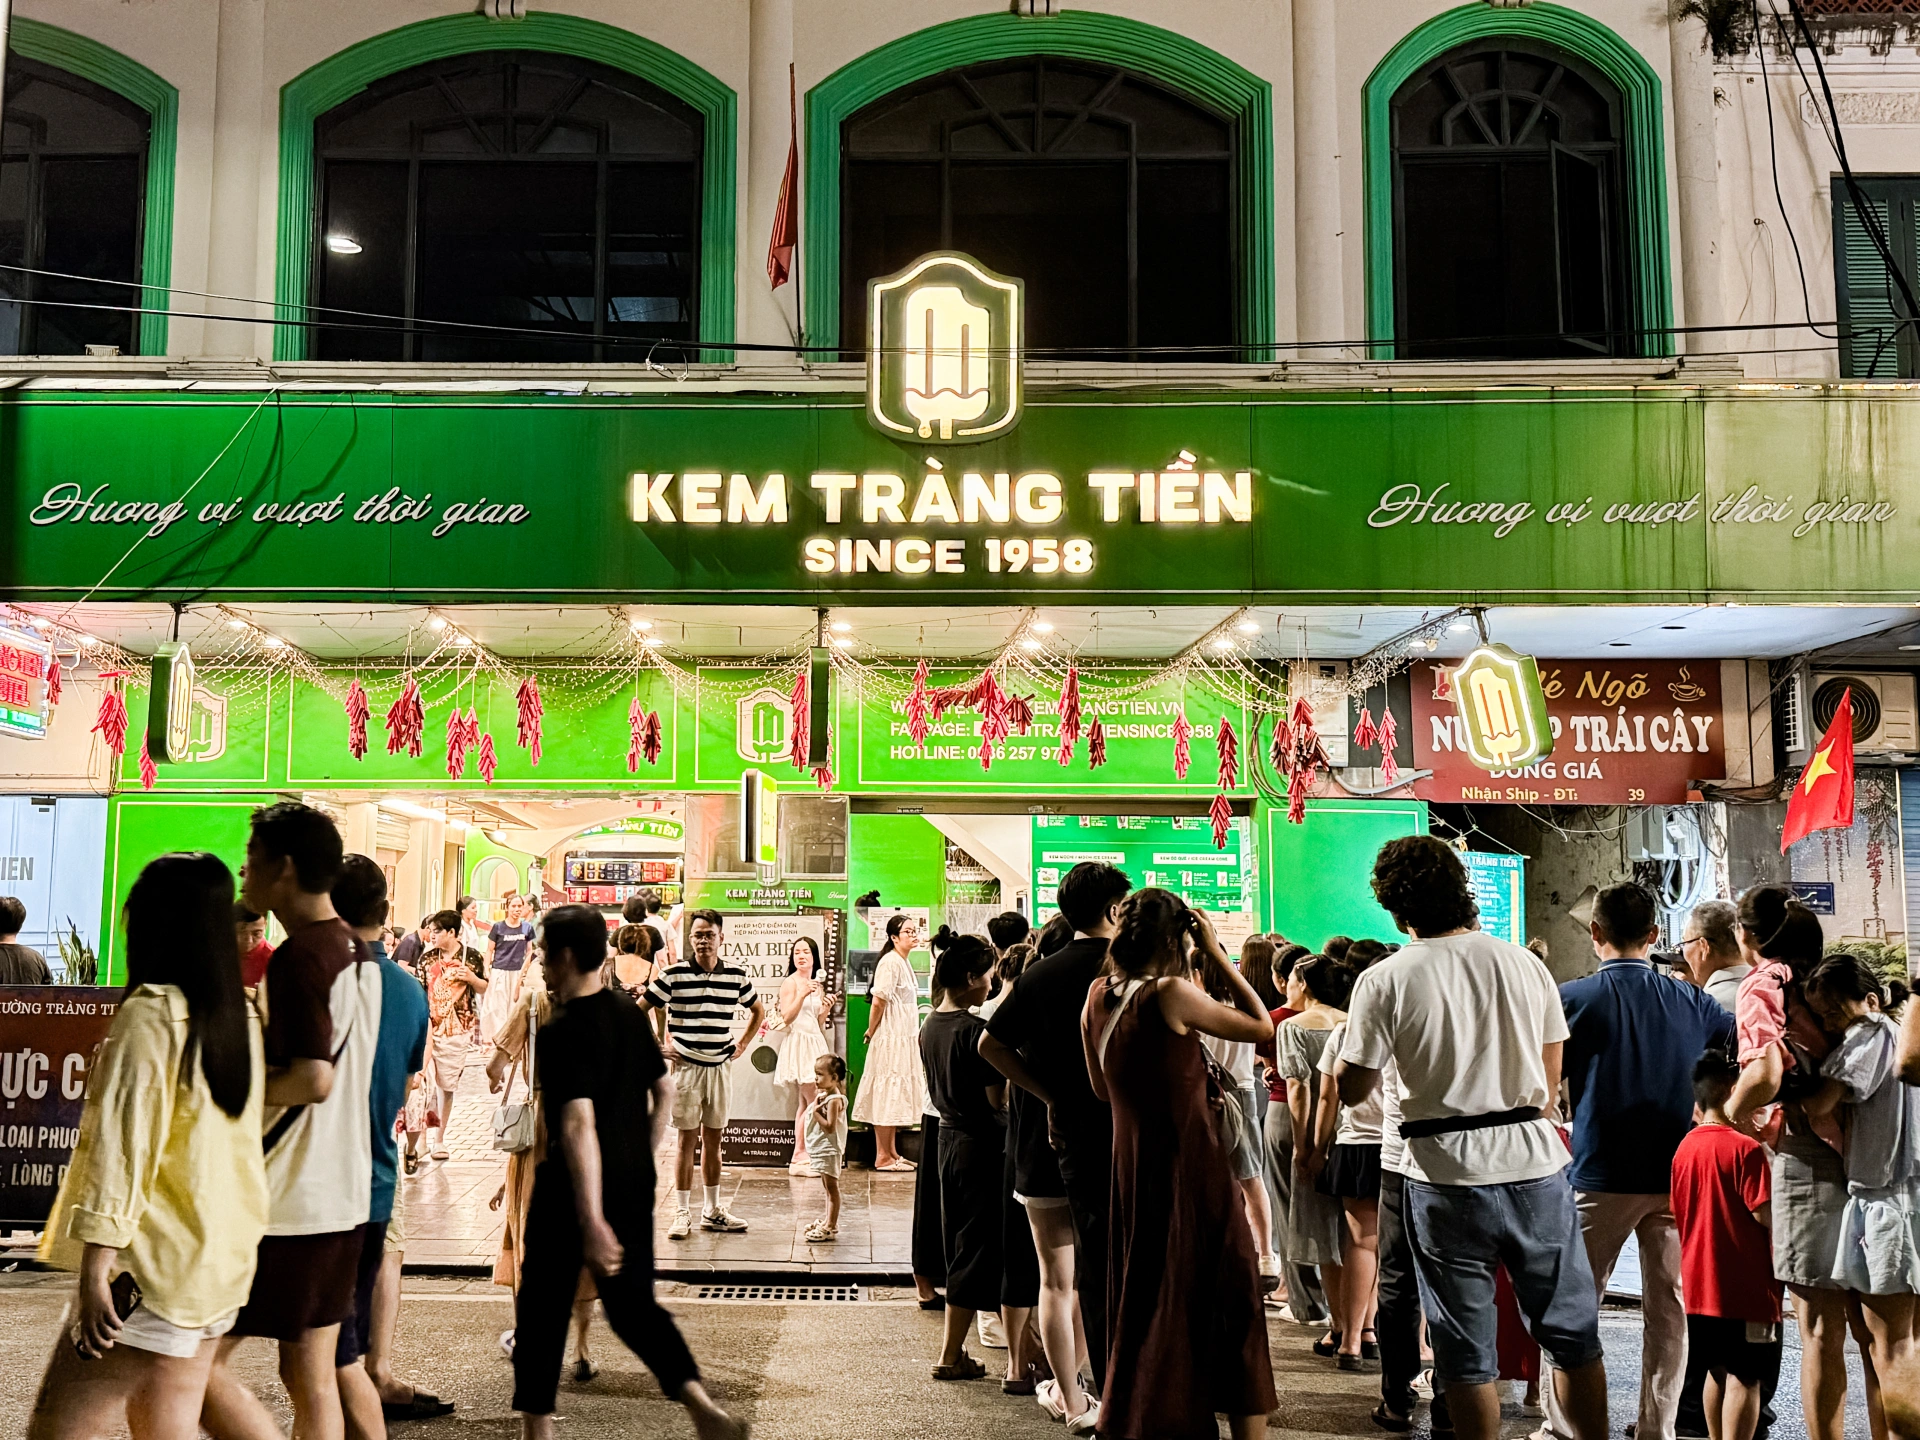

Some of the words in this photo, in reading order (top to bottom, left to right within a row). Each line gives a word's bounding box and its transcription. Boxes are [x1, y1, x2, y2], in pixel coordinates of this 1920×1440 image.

[632, 472, 788, 523] KEM
[810, 456, 1064, 524] TRÀNG
[1088, 449, 1254, 523] TIỀN
[198, 497, 243, 527] vị
[353, 486, 432, 523] thời
[432, 498, 530, 536] gian
[1546, 497, 1593, 527] vị
[1711, 484, 1793, 523] thời
[1792, 496, 1897, 537] gian
[804, 539, 966, 574] SINCE
[985, 539, 1094, 574] 1958
[1575, 671, 1651, 706] Ngõ
[1570, 705, 1647, 753] TRÁI
[1649, 707, 1714, 753] CÂY
[890, 745, 965, 760] HOTLINE:
[1008, 746, 1037, 760] 257
[1563, 758, 1603, 780] GIÁ
[1461, 787, 1500, 801] Nhận
[1505, 787, 1539, 801] Ship
[1554, 788, 1578, 801] ĐT:
[1628, 788, 1645, 800] 39
[725, 889, 748, 898] KEM
[750, 887, 786, 898] TRÀNG
[0, 999, 42, 1015] ƯỜNG
[45, 1000, 97, 1015] TRÀNG
[0, 1048, 50, 1110] ỰC
[759, 1128, 786, 1136] KHÁCH
[11, 1159, 54, 1187] LÒNG
